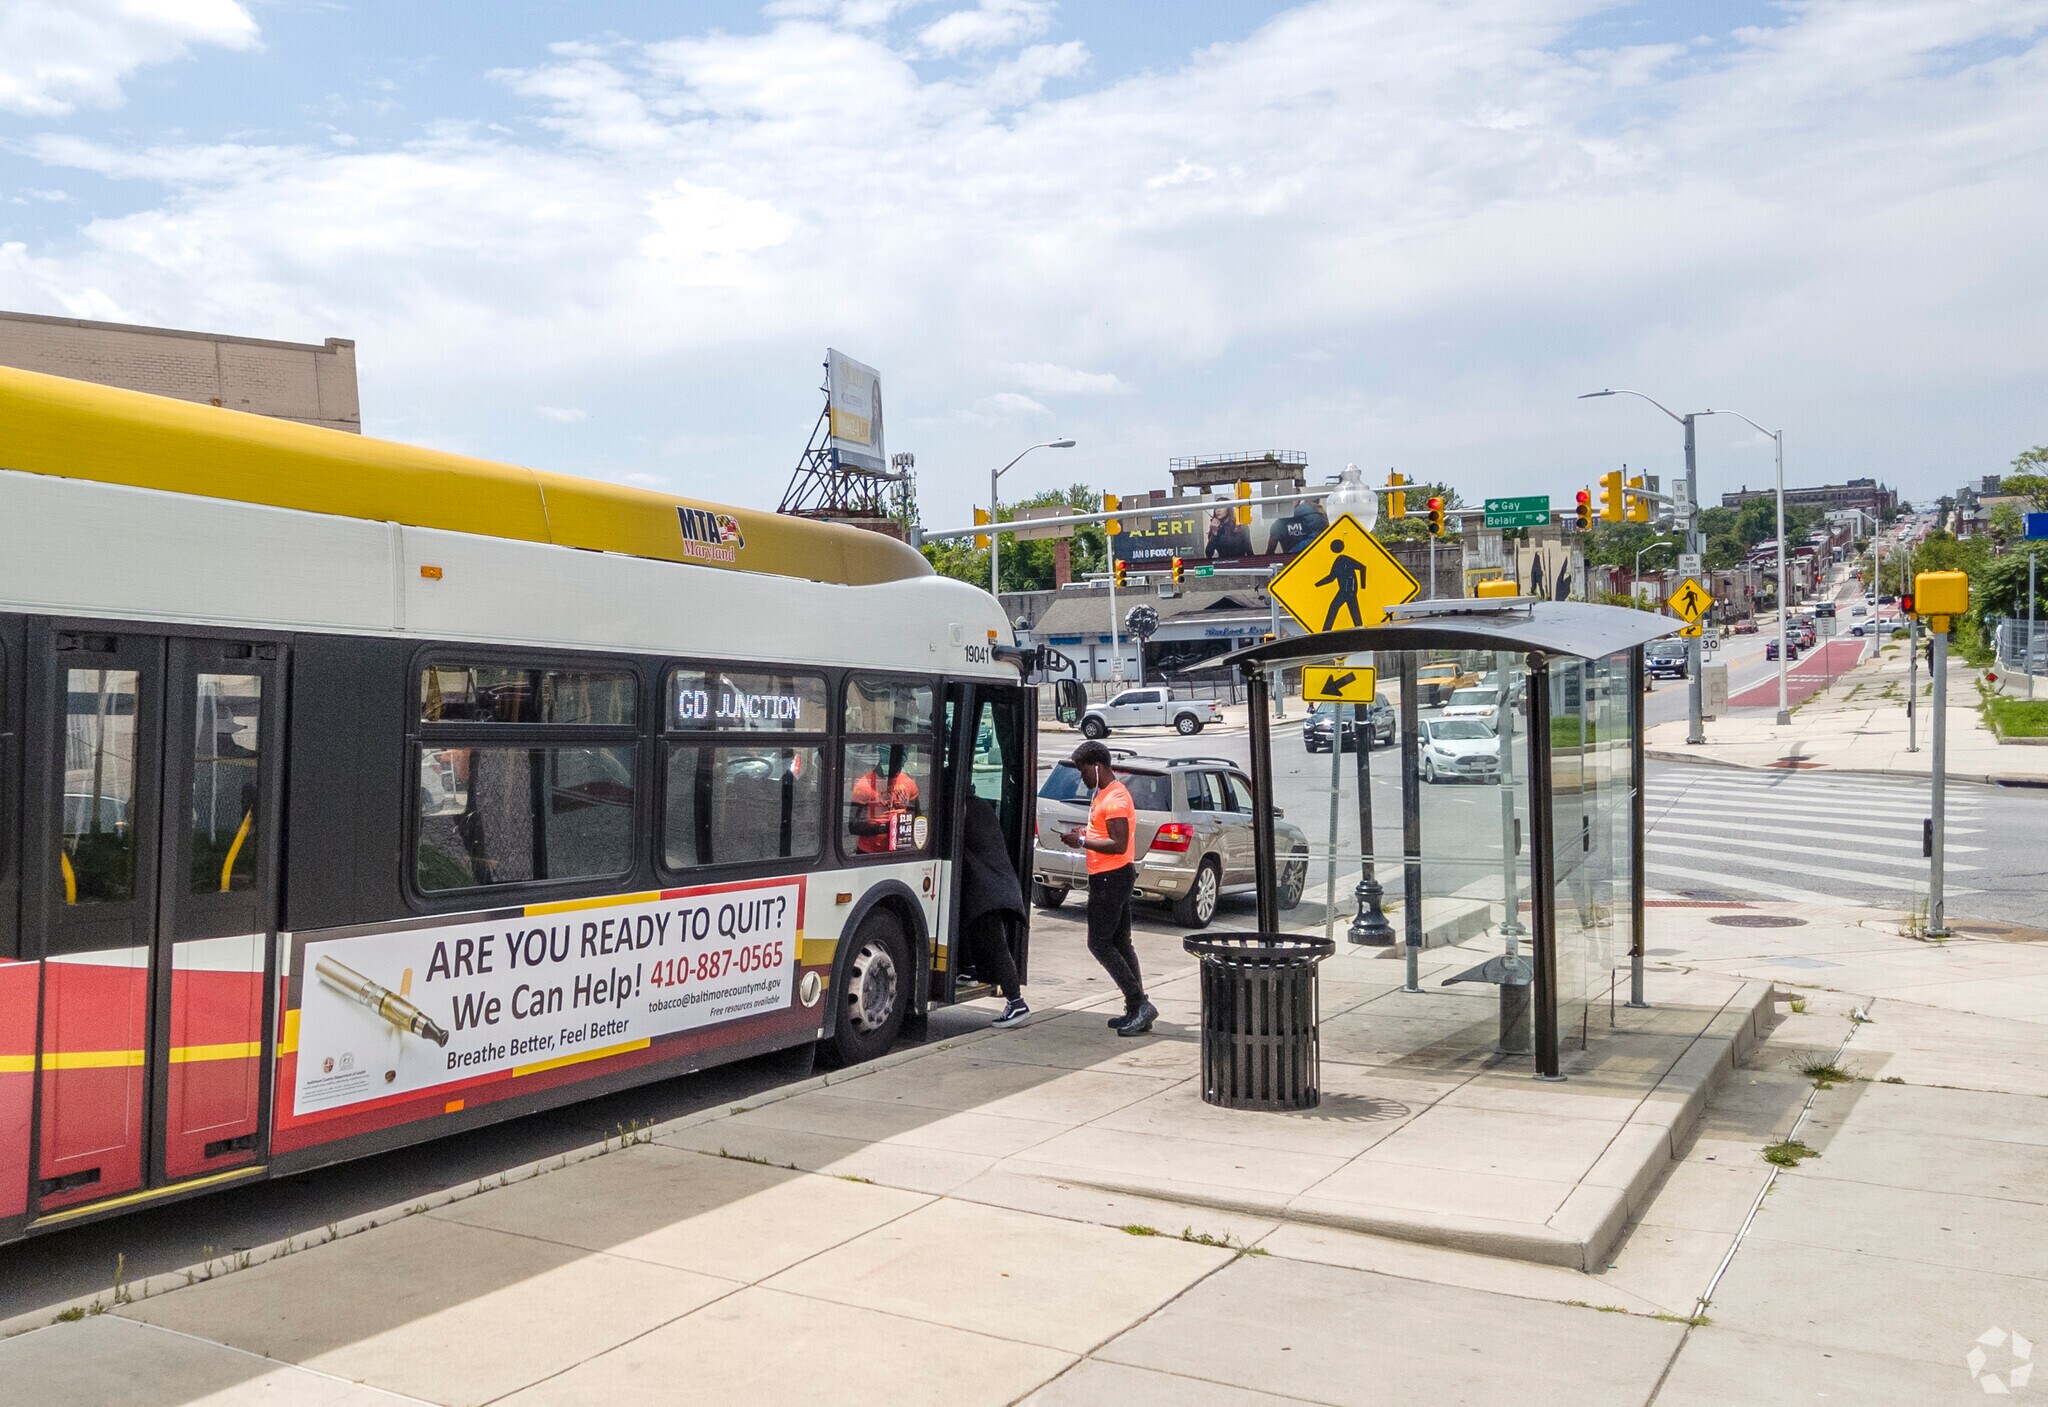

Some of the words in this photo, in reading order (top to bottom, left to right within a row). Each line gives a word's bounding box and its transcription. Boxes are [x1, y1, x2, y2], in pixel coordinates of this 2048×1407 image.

[1501, 501, 1520, 511] Gay
[677, 507, 722, 544] MTA
[1487, 515, 1517, 526] Belair
[683, 540, 735, 561] Maryland
[1132, 550, 1144, 558] JAN
[1145, 549, 1149, 558] 8
[964, 645, 989, 664] 19041
[1702, 640, 1718, 649] 30
[679, 690, 708, 719] GD
[715, 694, 801, 719] JUNCTION
[425, 935, 495, 982] ARE
[505, 925, 571, 969] YOU
[580, 911, 671, 958] READY
[678, 907, 710, 942] TO
[718, 895, 786, 940] QUIT?
[650, 941, 783, 988] 410-887-0565
[452, 991, 502, 1031] We
[511, 984, 563, 1020] Can
[572, 963, 642, 1010] Help!
[648, 978, 781, 1013] tobacco@baltimorecountymd.gov
[710, 1007, 724, 1017] Free
[724, 1001, 753, 1014] resources
[753, 994, 780, 1008] available
[447, 1043, 506, 1070] Breathe
[510, 1034, 556, 1056] Better,
[559, 1024, 587, 1046] Feel
[590, 1018, 629, 1039] Better
